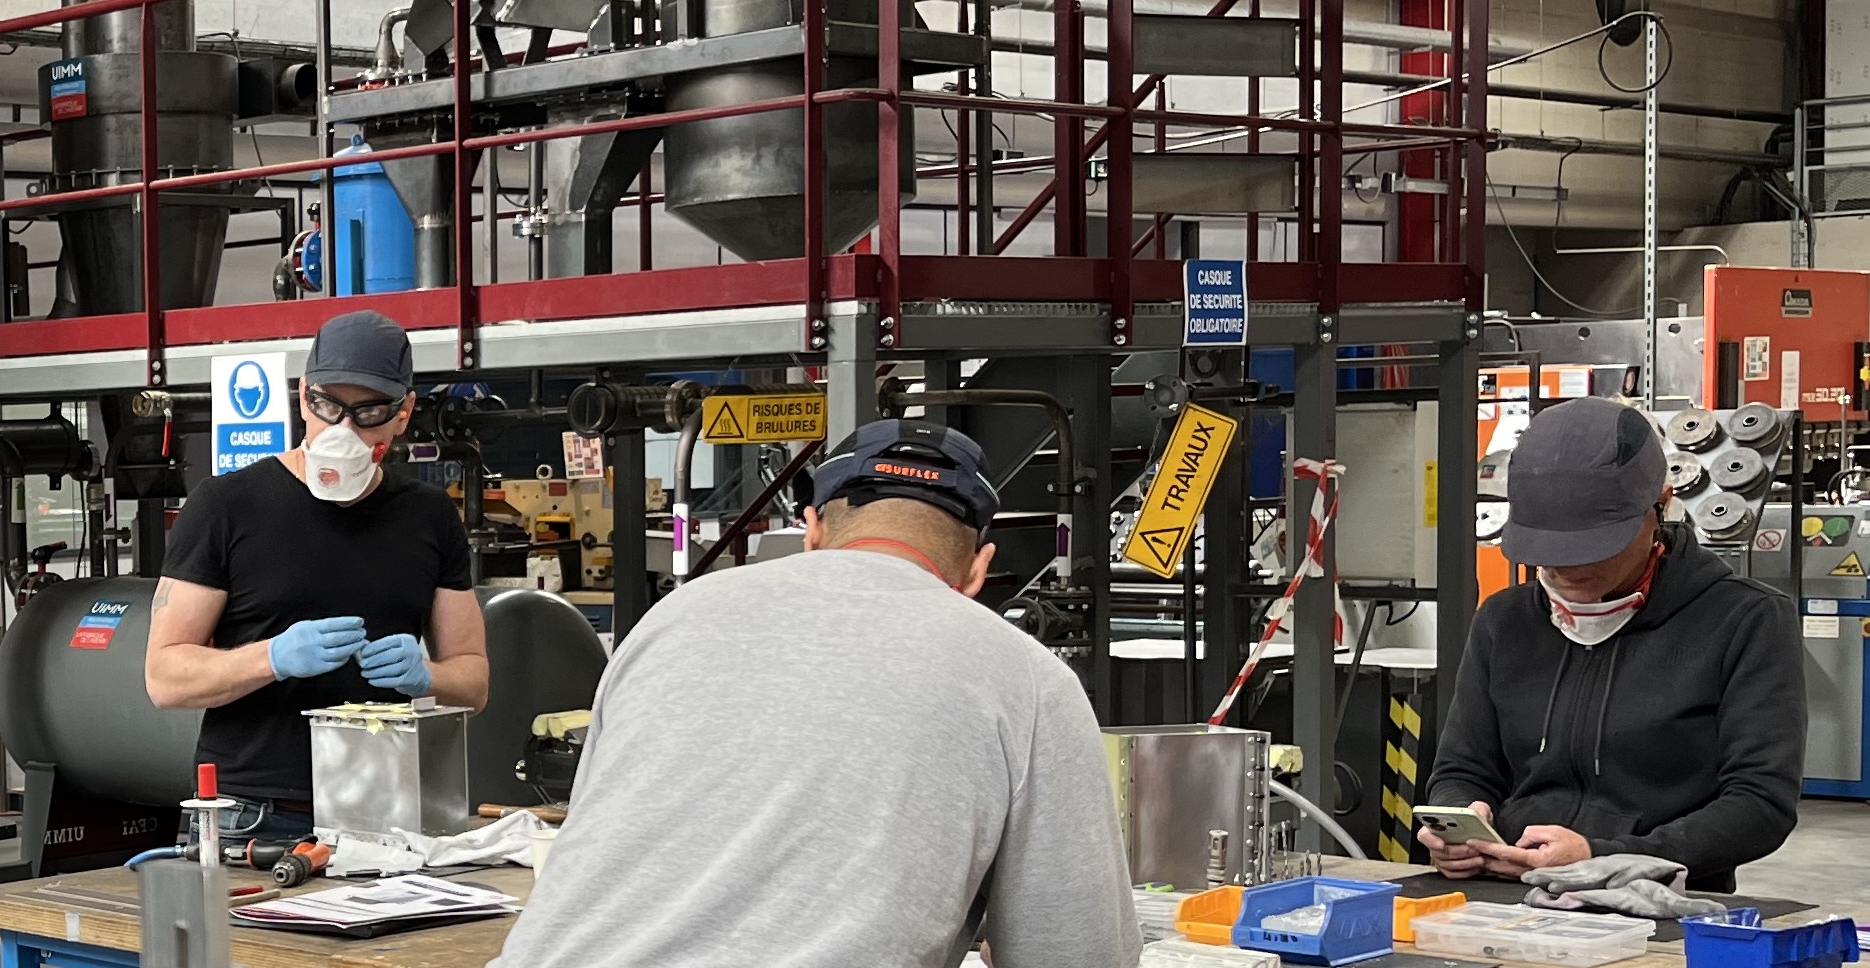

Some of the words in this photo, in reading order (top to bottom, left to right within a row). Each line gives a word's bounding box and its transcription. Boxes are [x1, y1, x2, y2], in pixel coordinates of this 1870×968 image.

[51, 62, 82, 80] UIMM
[1197, 269, 1233, 285] CASQUE
[1189, 293, 1202, 309] DE
[1202, 293, 1243, 309] SECURITE
[1189, 317, 1244, 333] OBLIGATOIRE
[752, 403, 802, 417] RISQUES
[805, 402, 821, 415] DE
[755, 420, 817, 434] BRULURES
[230, 430, 272, 446] CASQUE
[218, 453, 234, 468] DE
[1160, 420, 1216, 512] TRAVAUX
[91, 602, 129, 615] UIMM
